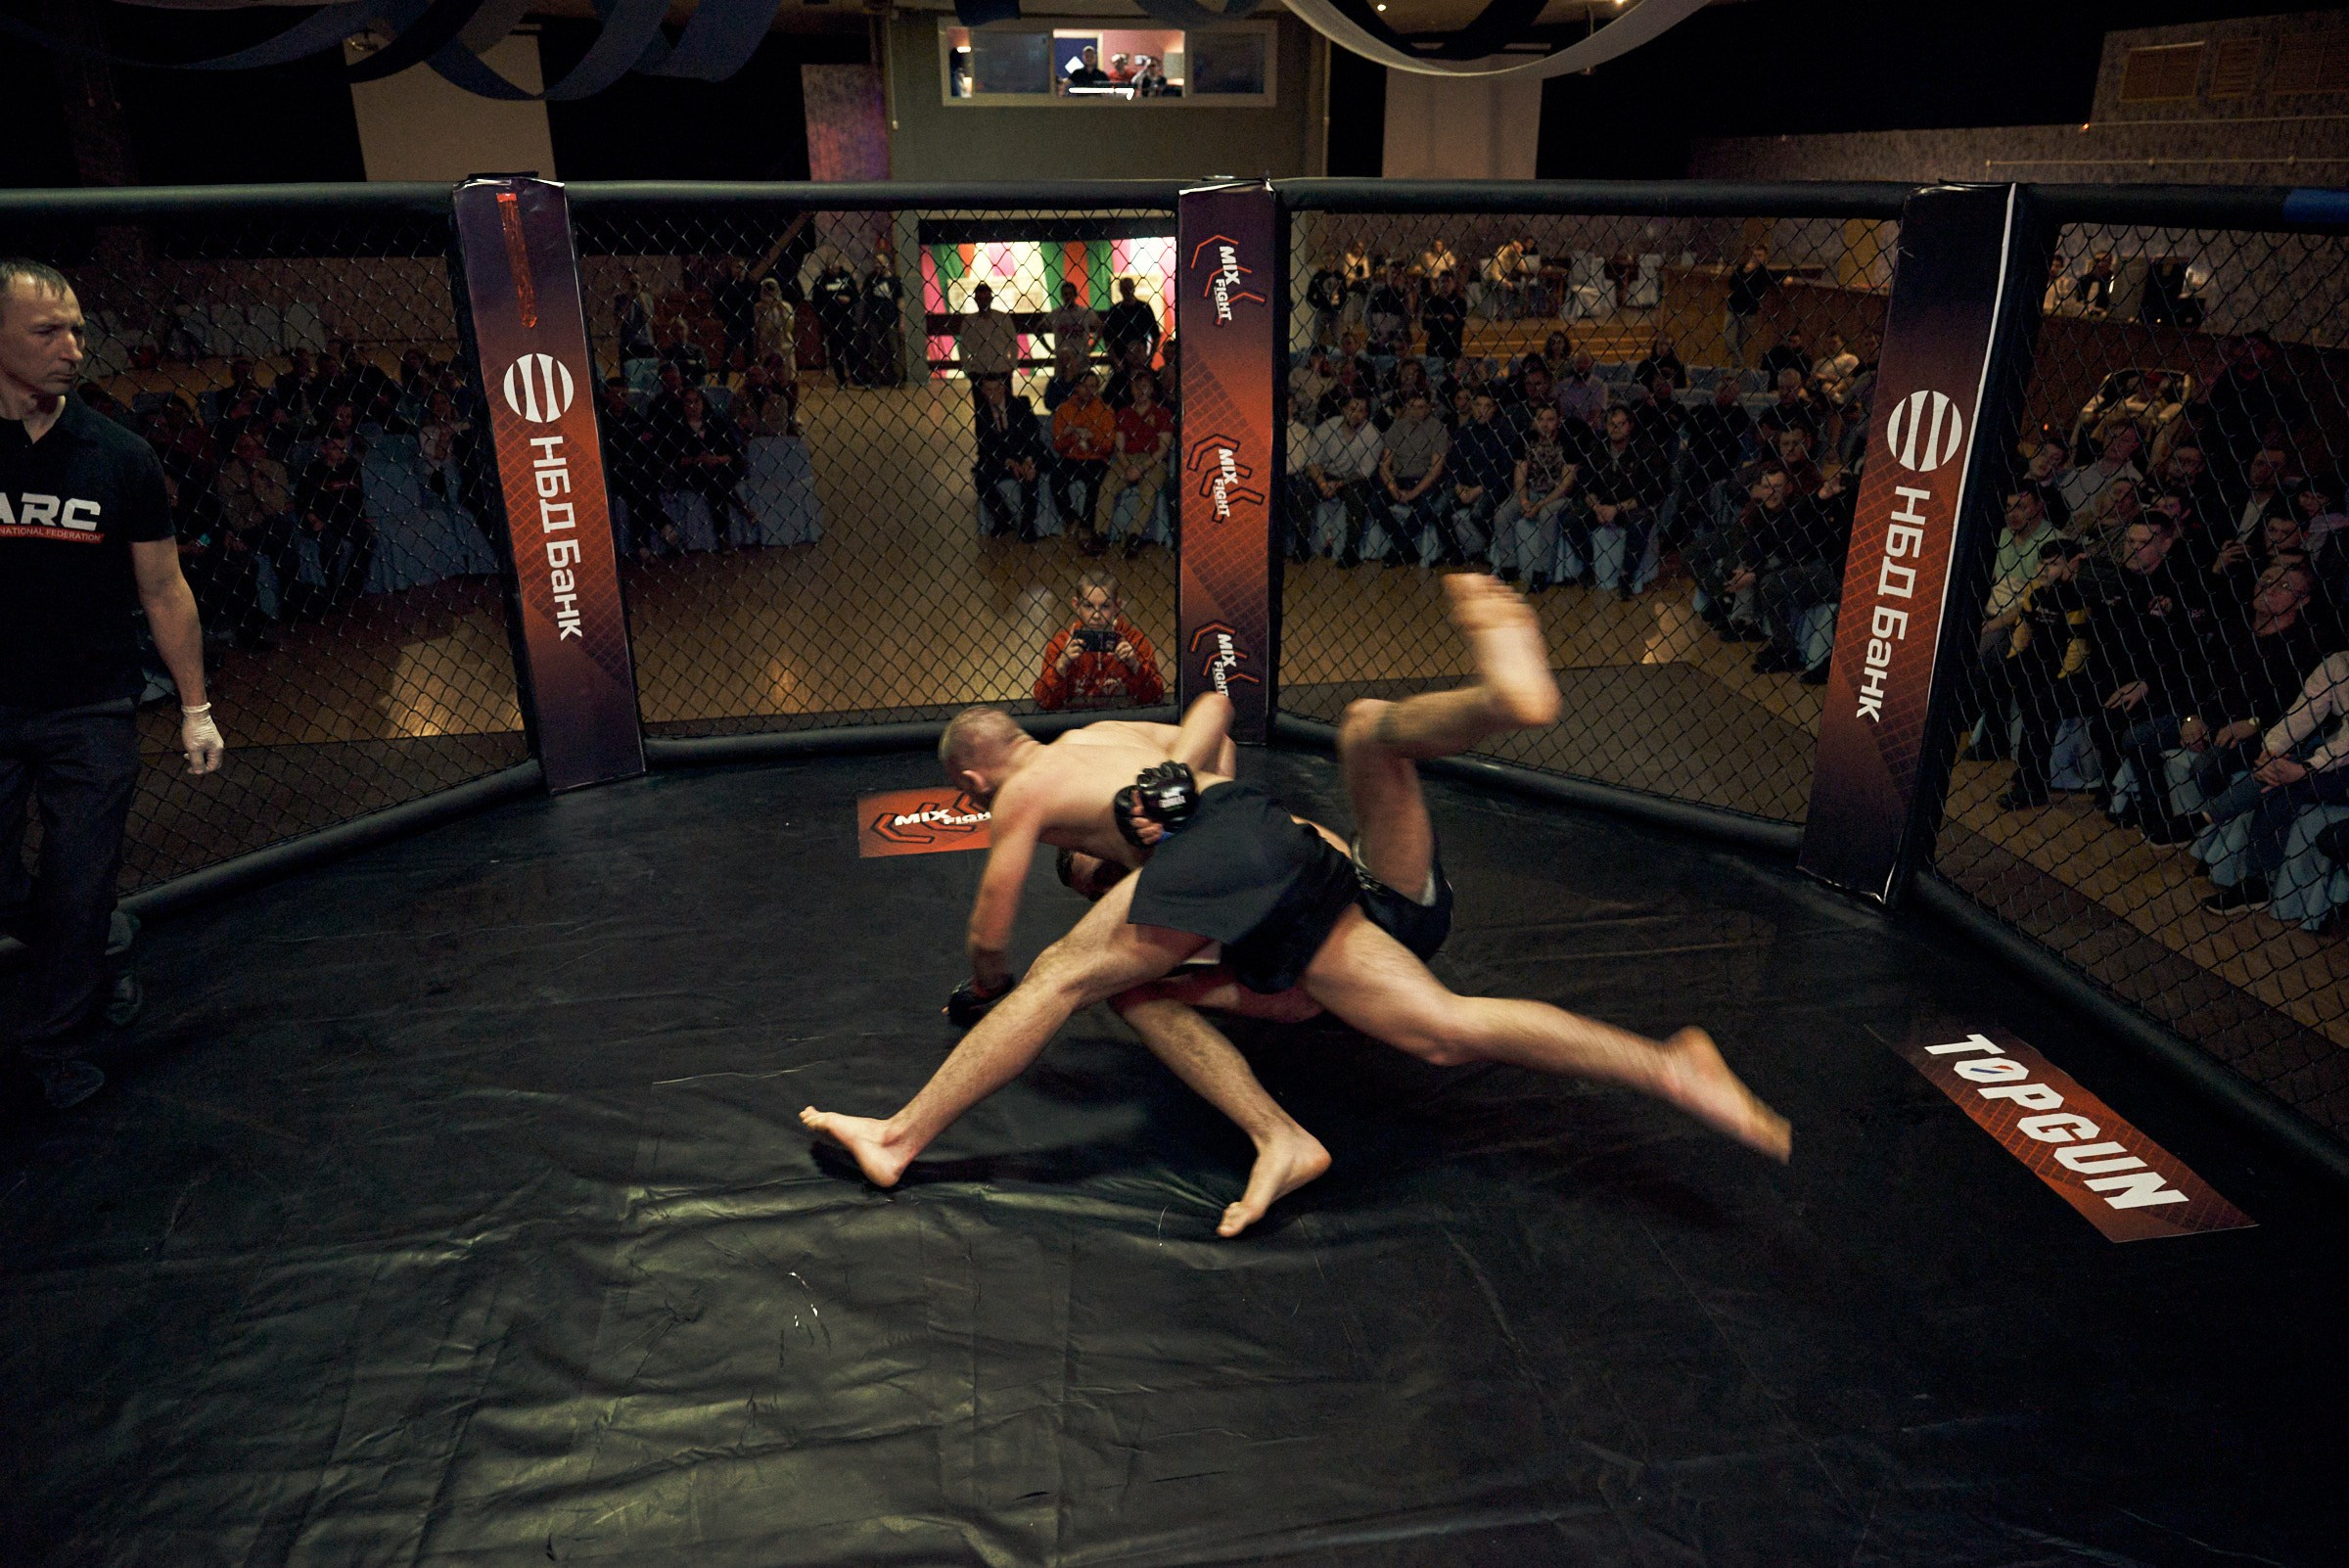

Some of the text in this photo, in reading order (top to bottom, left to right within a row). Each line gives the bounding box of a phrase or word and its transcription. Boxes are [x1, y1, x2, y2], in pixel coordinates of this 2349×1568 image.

[1215, 246, 1241, 321] MIX FIGHT
[1214, 448, 1238, 517] MIX FIGHT
[46, 530, 101, 541] FEDERATION
[530, 436, 583, 641] НБД Банк
[1856, 485, 1930, 723] НБД Банк
[1217, 633, 1237, 668] MIX
[895, 809, 991, 826] MIX FIGH
[1924, 1034, 2189, 1210] TOPGUN
